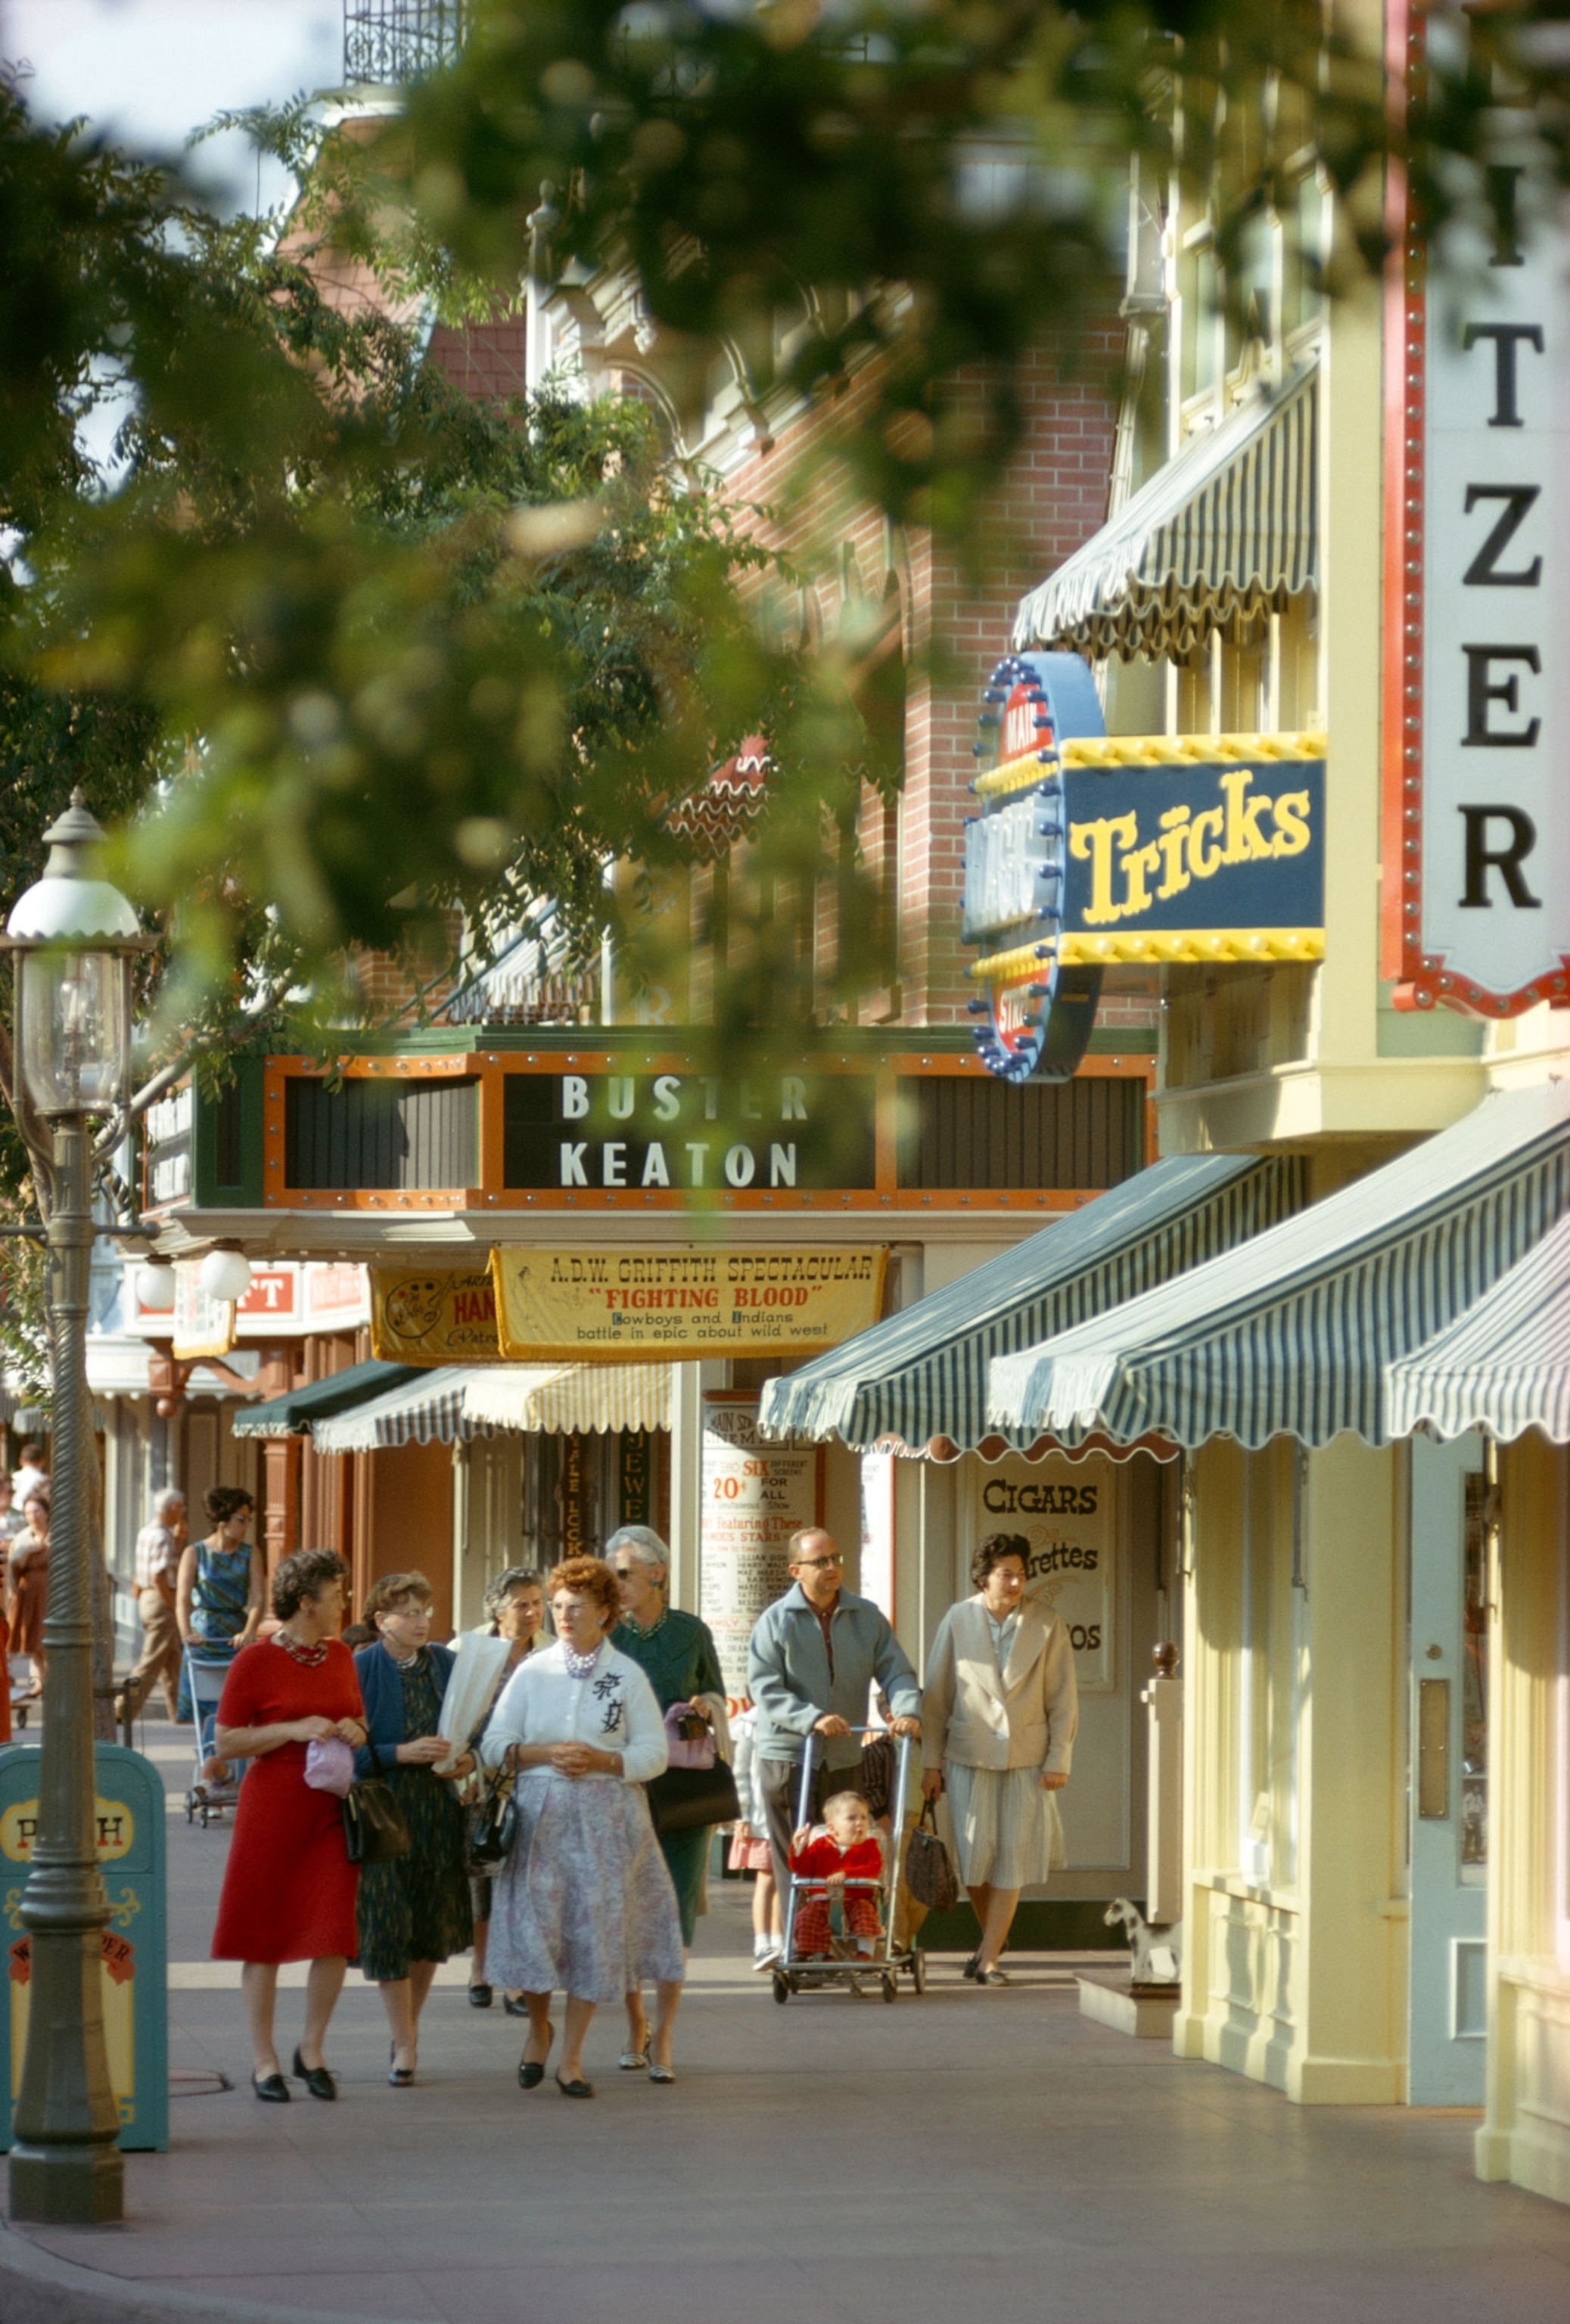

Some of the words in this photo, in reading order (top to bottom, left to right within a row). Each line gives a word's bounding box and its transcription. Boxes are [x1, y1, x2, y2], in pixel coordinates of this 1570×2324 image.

[1068, 769, 1312, 925] Tricks
[562, 1074, 808, 1121] BUSTER
[560, 1142, 797, 1188] KEATON
[618, 1257, 717, 1282] GRIFFITH
[728, 1256, 872, 1282] SPECTACULAR
[577, 1327, 622, 1340] battle
[631, 1327, 644, 1339] in
[653, 1327, 689, 1341] epic
[698, 1325, 742, 1338] about
[751, 1324, 782, 1337] wild
[790, 1322, 829, 1335] west
[612, 1312, 682, 1328] Cowboys
[692, 1312, 722, 1324] and
[732, 1310, 794, 1324] Indians
[742, 1459, 769, 1477] SIX
[760, 1477, 788, 1487] FOR
[760, 1490, 786, 1500] ALL
[983, 1479, 1098, 1515] CIGARS
[741, 1532, 782, 1542] STARS
[1028, 1541, 1099, 1578] rettes
[17, 1817, 123, 1849] PH
